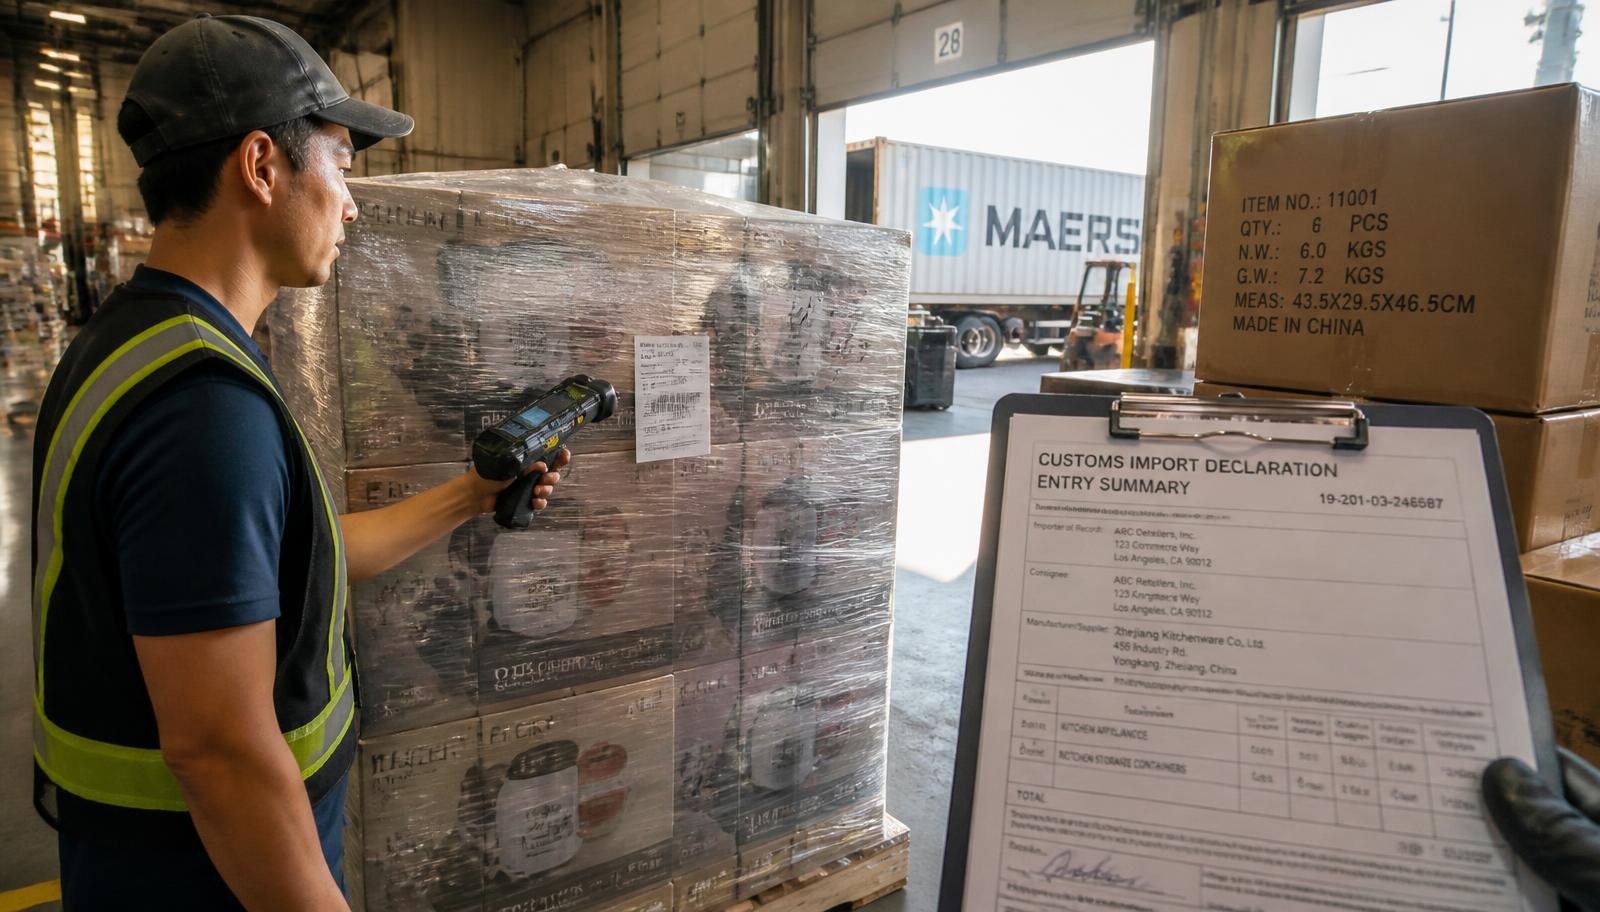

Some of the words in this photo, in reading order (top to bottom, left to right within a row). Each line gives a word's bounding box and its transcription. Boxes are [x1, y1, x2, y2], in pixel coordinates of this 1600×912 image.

[938, 28, 961, 58] 28
[1242, 195, 1280, 213] ITEM
[1286, 193, 1321, 211] NO.:
[1328, 188, 1378, 208] 11001
[1240, 220, 1281, 237] QTY.:
[1311, 216, 1322, 234] 6
[1350, 213, 1389, 232] PCS
[1238, 244, 1280, 261] N.W.:
[1300, 242, 1327, 259] 6.0
[1347, 240, 1387, 259] KGS
[1237, 268, 1279, 285] G.W.:
[1299, 267, 1324, 285] 7.2
[1344, 267, 1384, 285] KGS
[1234, 292, 1285, 309] MEAS:
[1292, 293, 1476, 314] 43.5X29.5X46.5CM
[1233, 316, 1278, 333] MADE
[1284, 317, 1301, 334] IN
[1307, 318, 1365, 337] CHINA
[1038, 452, 1125, 469] CUSTOMS
[1130, 456, 1200, 472] IMPORT
[1205, 459, 1338, 477] DECLARATION
[1037, 474, 1095, 490] ENTRY
[1100, 477, 1191, 495] SUMMARY
[1114, 540, 1130, 550] 123
[1179, 544, 1200, 555] Way
[1113, 553, 1129, 562] Los
[1170, 557, 1184, 566] CA
[1113, 603, 1129, 613] Los
[1170, 607, 1184, 617] CA
[1162, 629, 1225, 645] Kitchenware
[1209, 664, 1238, 676] China
[1017, 789, 1046, 803] TOTAL
